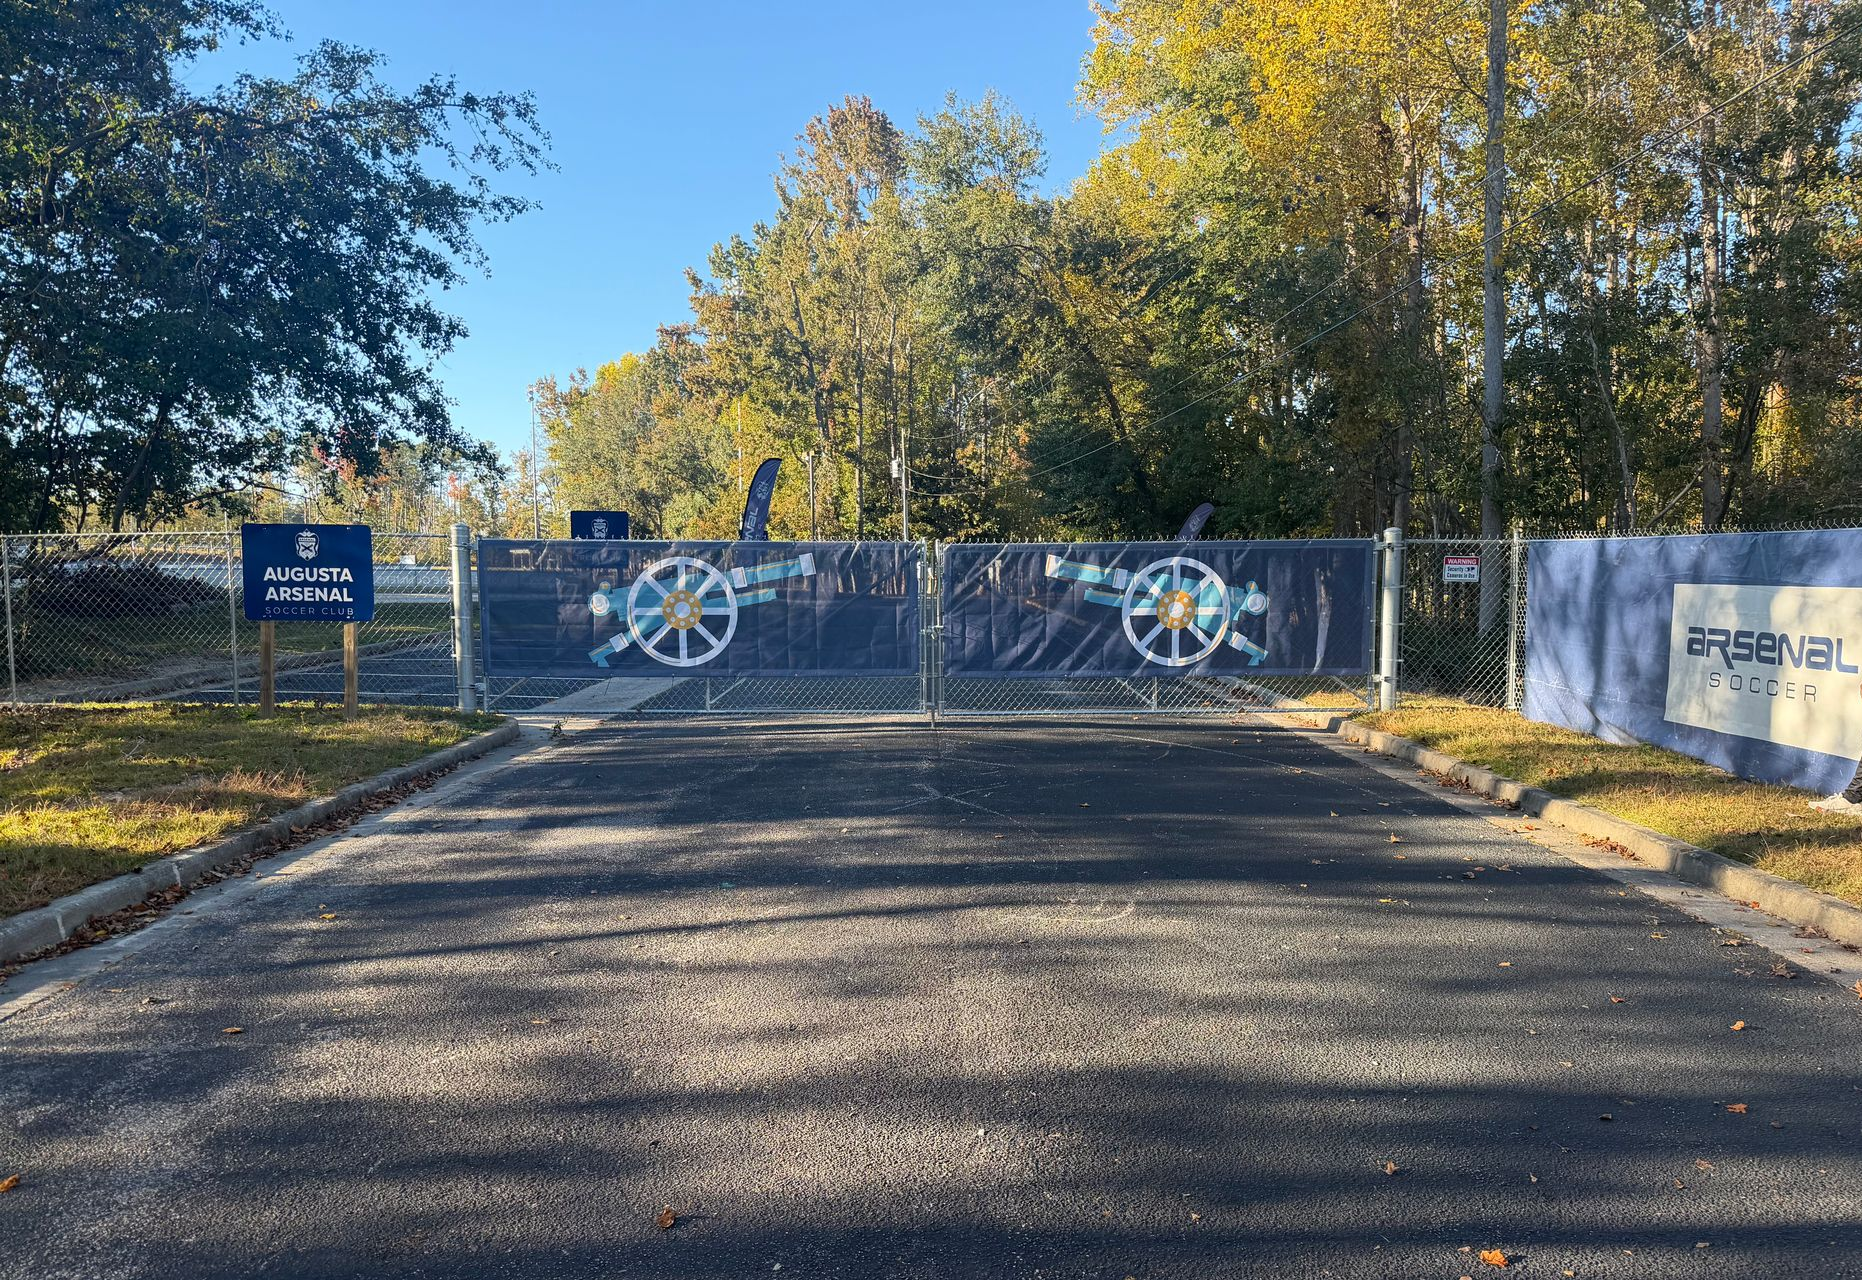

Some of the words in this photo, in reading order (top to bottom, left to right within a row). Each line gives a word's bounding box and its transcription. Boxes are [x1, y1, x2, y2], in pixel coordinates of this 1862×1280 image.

[263, 567, 354, 582] AUGUSTA
[265, 587, 354, 602] ARSENAL
[265, 606, 315, 615] SOCCER
[321, 607, 354, 616] CLUB
[1708, 672, 1817, 703] SOCCER
